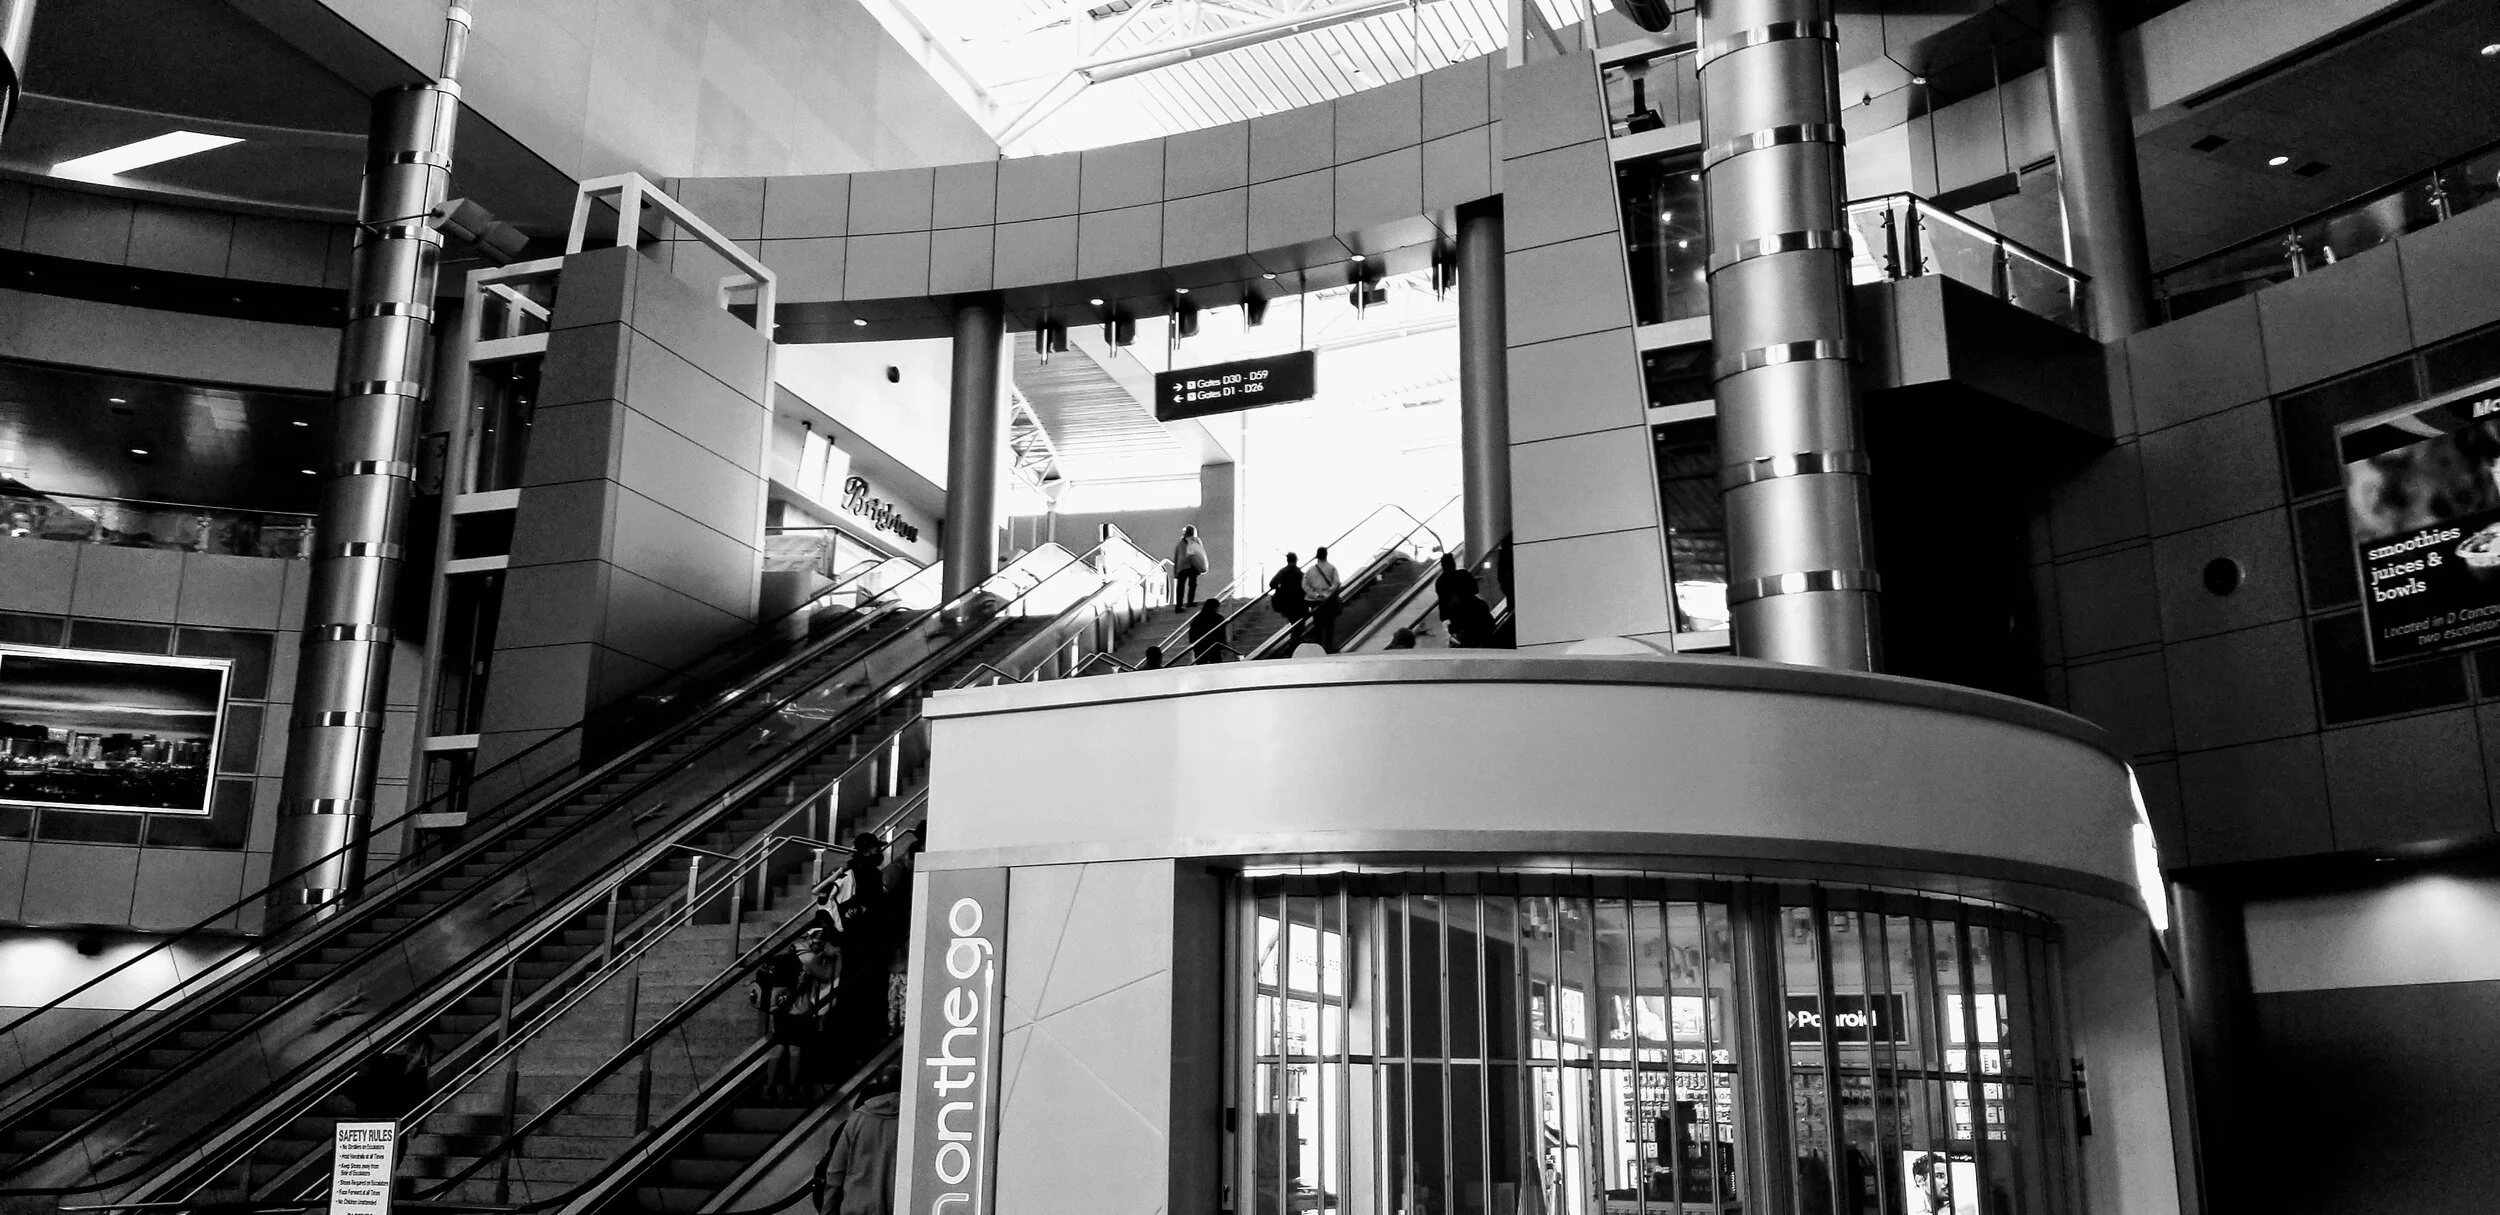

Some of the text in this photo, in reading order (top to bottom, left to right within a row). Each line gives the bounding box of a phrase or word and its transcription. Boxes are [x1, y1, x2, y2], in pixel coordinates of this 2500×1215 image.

[1197, 379, 1221, 389] Gates
[1223, 373, 1242, 385] D30
[1249, 369, 1269, 381] D59
[1197, 390, 1222, 400] Gates
[1223, 386, 1235, 396] D1
[1244, 382, 1264, 393] D26
[841, 476, 919, 543] Brighton
[2368, 528, 2461, 561] smoothies
[2370, 551, 2443, 586] juices &
[2373, 577, 2427, 602] bowls
[2446, 612, 2457, 624] D
[338, 1129, 393, 1142] SAFETY RULES
